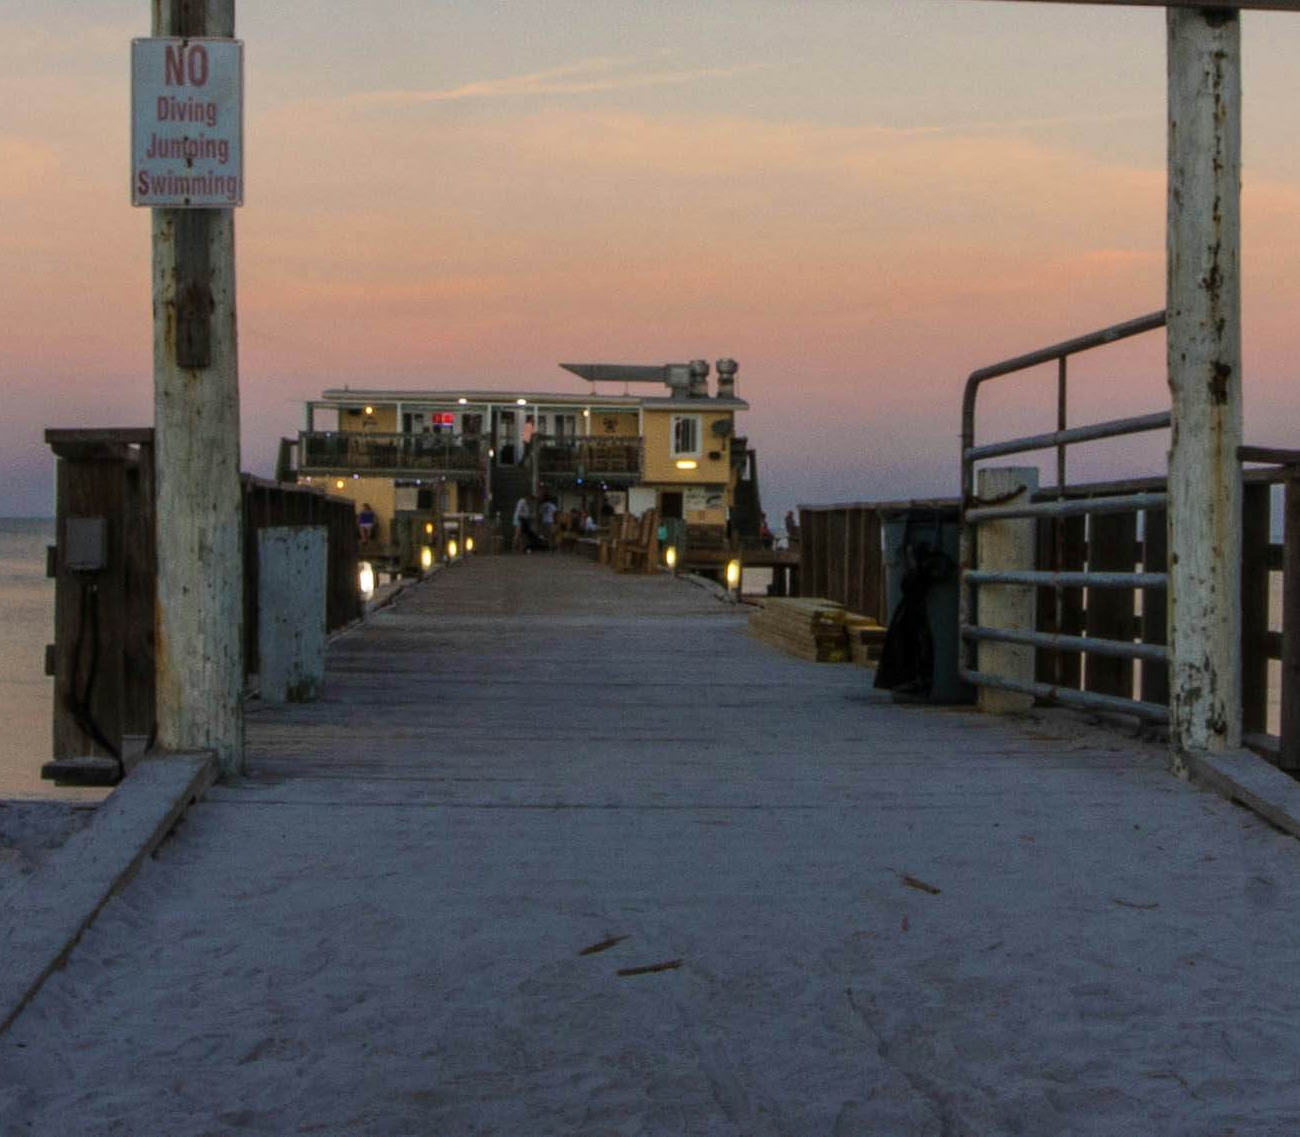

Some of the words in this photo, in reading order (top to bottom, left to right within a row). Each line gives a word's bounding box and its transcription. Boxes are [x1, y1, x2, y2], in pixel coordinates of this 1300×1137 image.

[164, 44, 209, 88] NO
[156, 96, 216, 127] Diving
[146, 132, 229, 164] Jumping
[137, 169, 237, 201] Swimming
